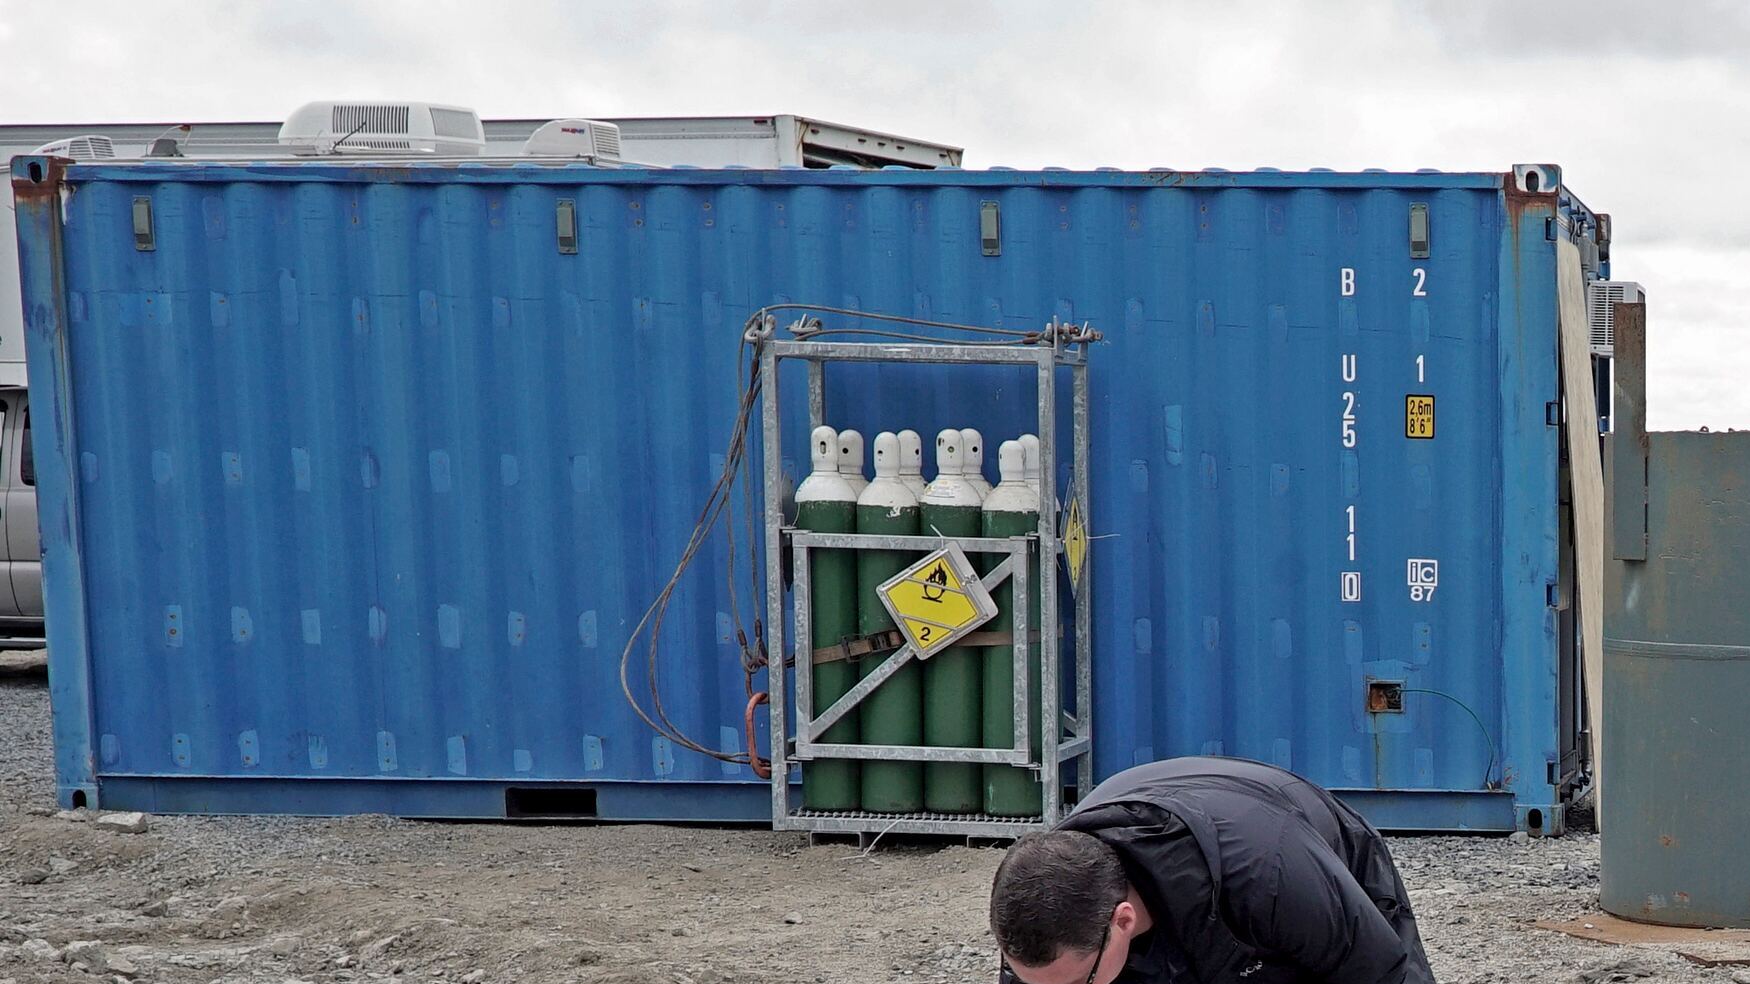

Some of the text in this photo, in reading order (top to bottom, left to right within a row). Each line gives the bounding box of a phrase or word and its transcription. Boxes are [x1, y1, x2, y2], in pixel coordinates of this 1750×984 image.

[1341, 268, 1355, 296] B
[1413, 268, 1426, 296] 2
[1410, 585, 1435, 602] 87
[920, 626, 931, 642] 2
